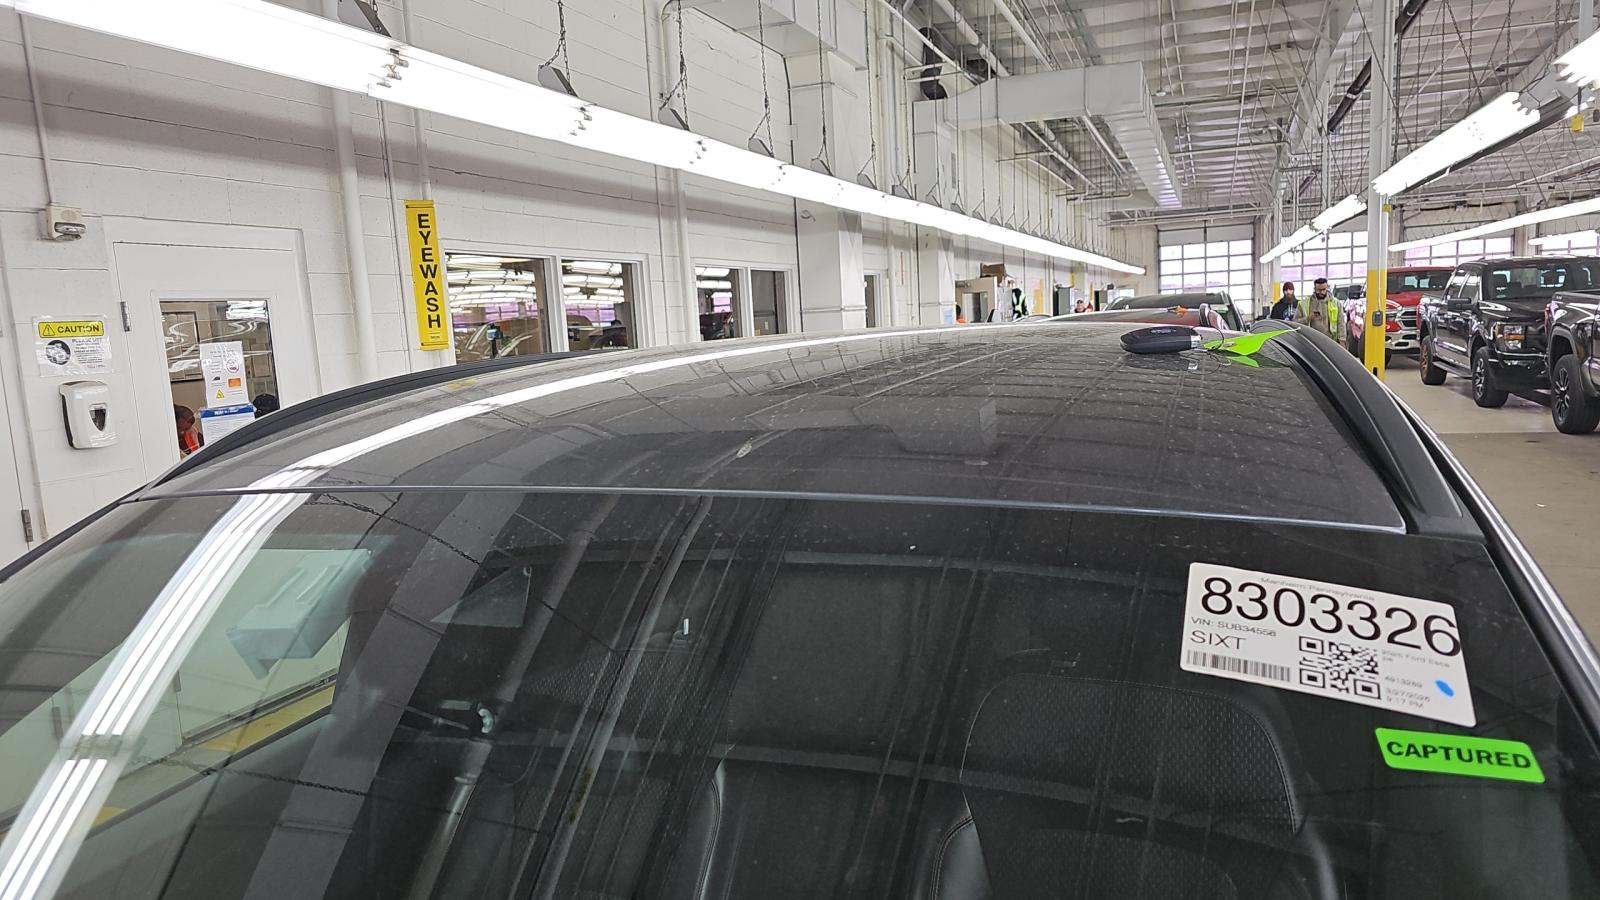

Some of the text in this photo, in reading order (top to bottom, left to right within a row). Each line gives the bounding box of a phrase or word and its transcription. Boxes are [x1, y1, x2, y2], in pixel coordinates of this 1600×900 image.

[417, 214, 441, 328] EYEWASH
[57, 325, 100, 335] CAUTION
[1191, 616, 1212, 626] VIN:
[1201, 577, 1461, 657] 8303326
[1190, 630, 1246, 650] SIXT
[1387, 741, 1531, 769] CAPTURED
